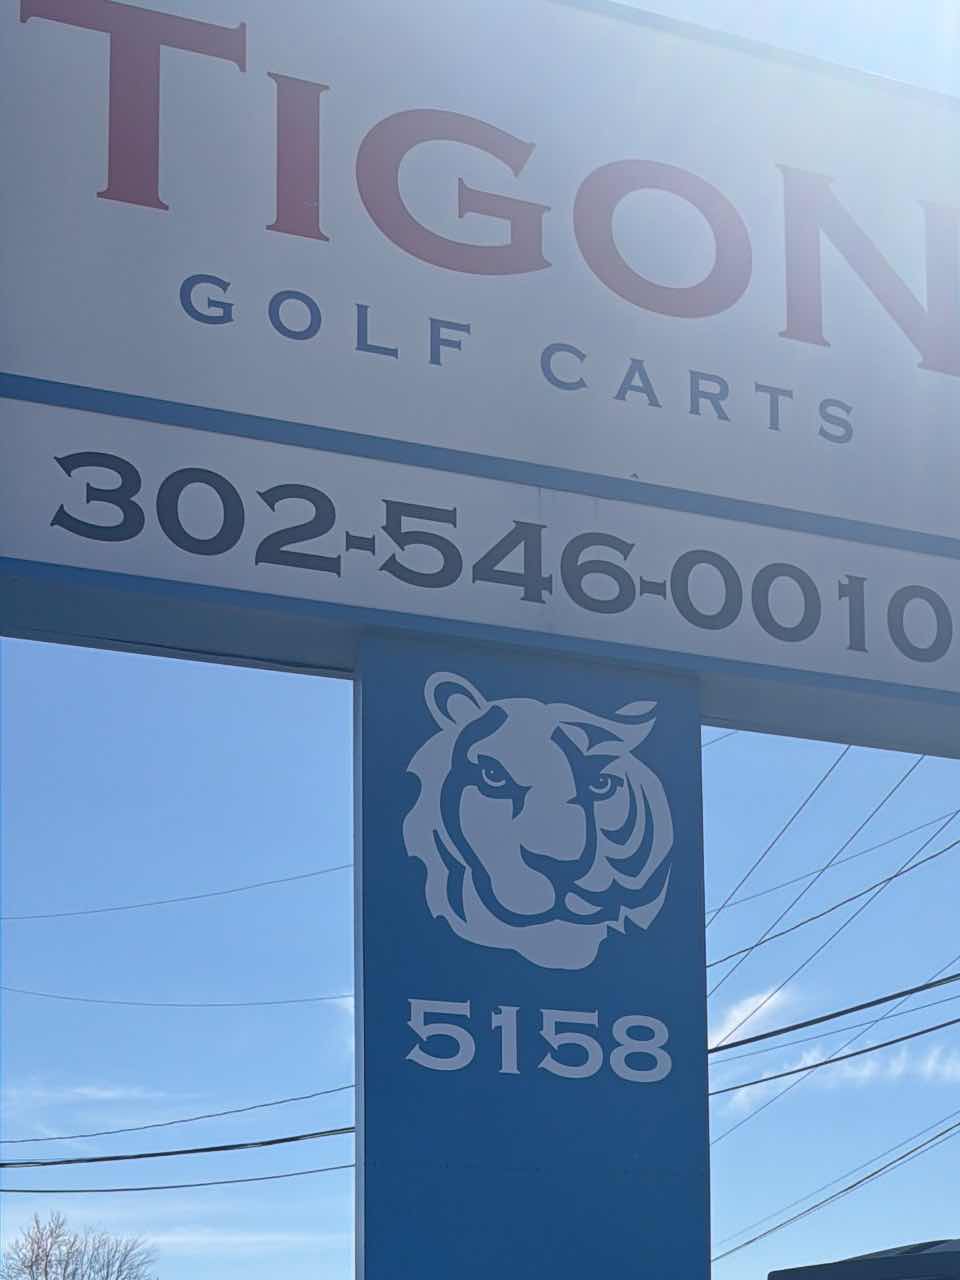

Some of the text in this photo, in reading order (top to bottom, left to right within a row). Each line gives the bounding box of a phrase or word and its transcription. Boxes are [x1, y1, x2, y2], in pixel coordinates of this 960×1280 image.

[178, 273, 855, 445] GOLF CARTS
[49, 450, 954, 664] 302-546-0010
[405, 998, 673, 1083] 5158
